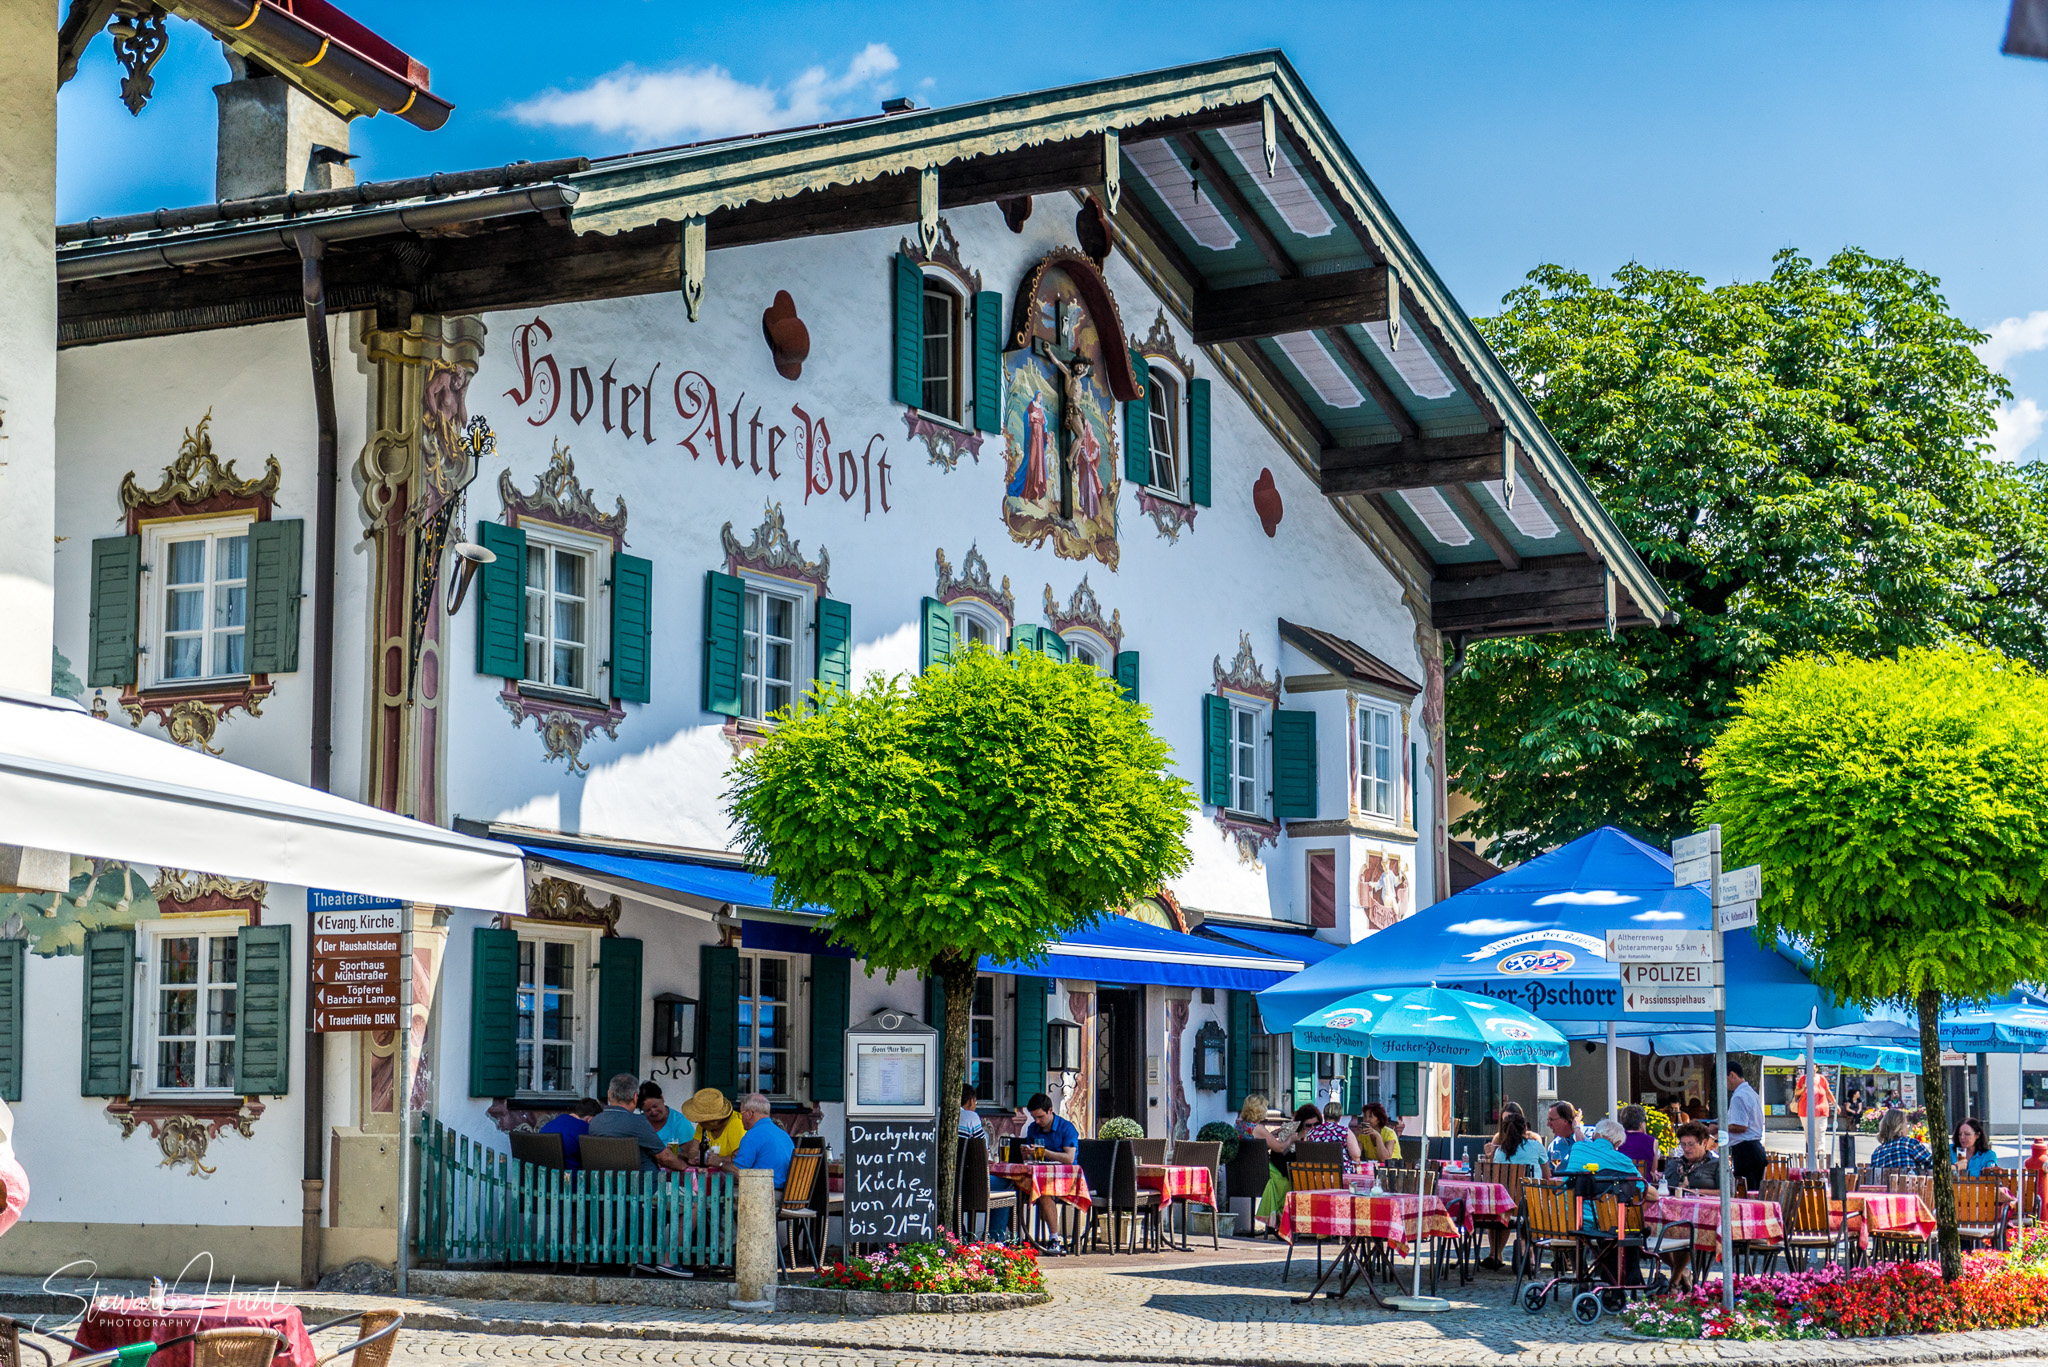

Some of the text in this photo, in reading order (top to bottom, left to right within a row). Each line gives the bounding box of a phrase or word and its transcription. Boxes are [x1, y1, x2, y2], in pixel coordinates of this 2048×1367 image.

[503, 315, 660, 445] Hotel
[674, 370, 787, 481] Alte
[325, 914, 394, 932] Evang. Kirche
[1617, 933, 1664, 942] Altherrenweg
[323, 940, 397, 952] Der Haushaltsladen
[1617, 944, 1673, 952] Unterammergau
[1686, 943, 1698, 951] km
[339, 960, 385, 973] Sporthaus
[335, 970, 389, 981] Mühlstraßer
[1637, 967, 1701, 982] POLIZEI
[347, 985, 384, 995] Töpferei
[327, 995, 396, 1005] Barbara Lampe
[1640, 994, 1706, 1007] Passionsspielhaus
[329, 1013, 396, 1026] TrauerHilfe DENK
[1304, 1031, 1363, 1048] Hacker-Pschorr
[871, 1045, 886, 1053] Hotel
[1382, 1040, 1471, 1057] Hacker-Pschorr
[1496, 1043, 1556, 1060] Hacker-Pschorr
[849, 1125, 935, 1151] Durchgehend
[856, 1149, 927, 1165] warme
[856, 1169, 921, 1193] Küche
[851, 1199, 884, 1213] von
[849, 1220, 877, 1236] bis
